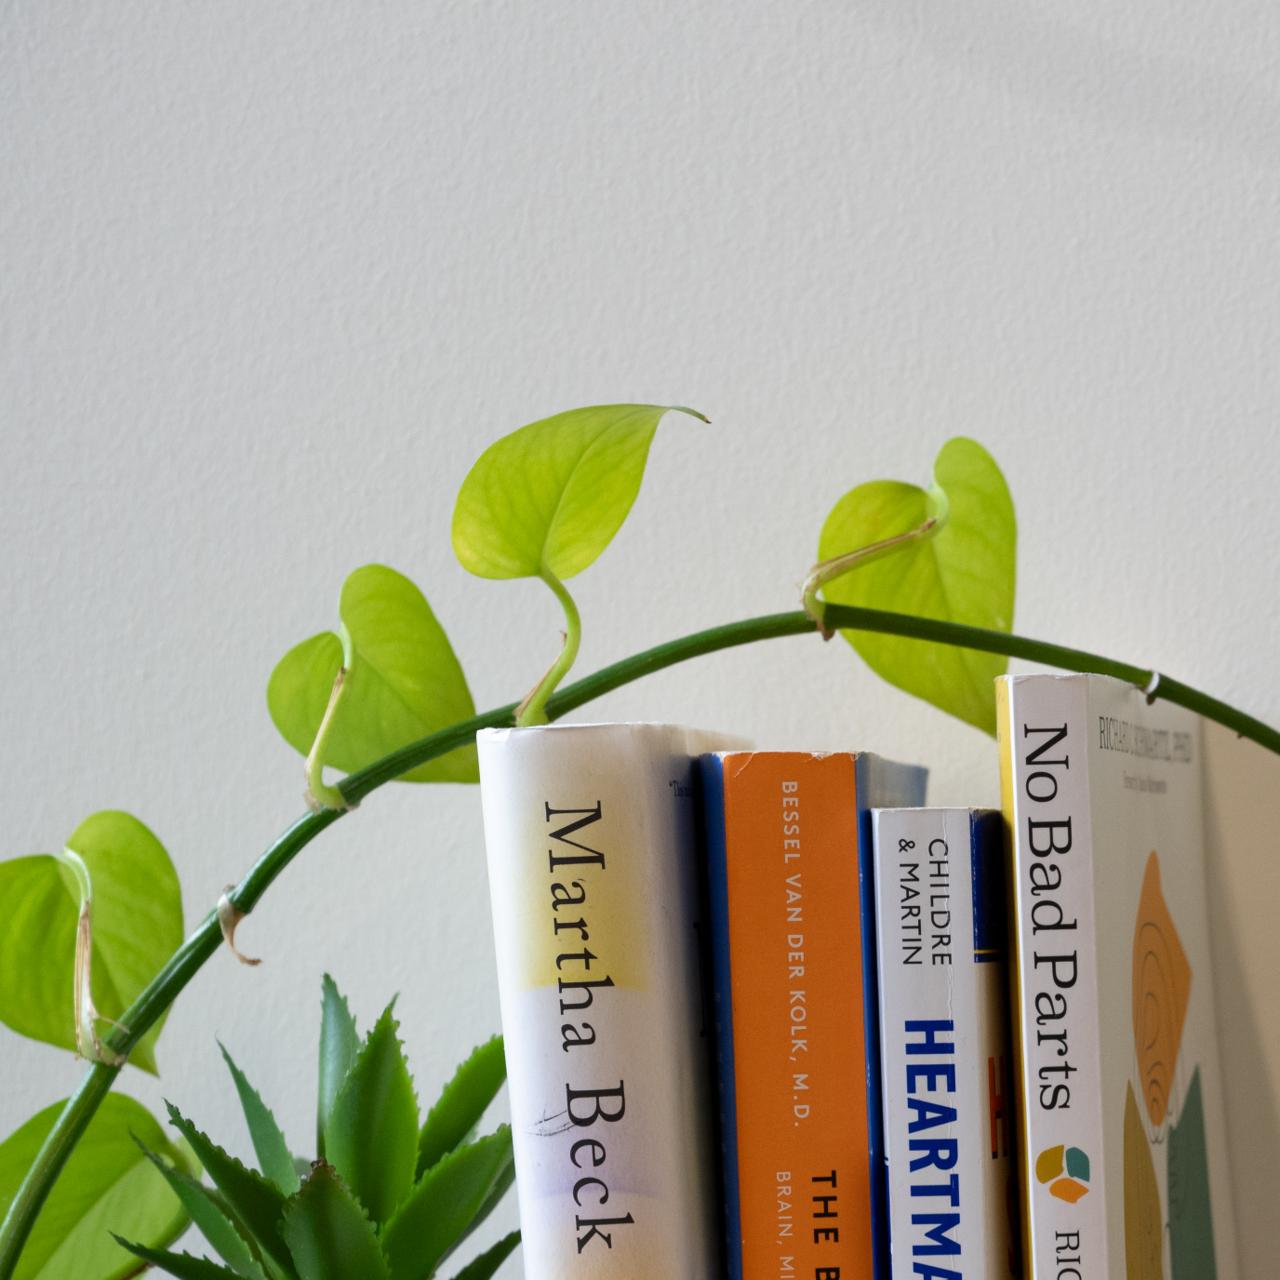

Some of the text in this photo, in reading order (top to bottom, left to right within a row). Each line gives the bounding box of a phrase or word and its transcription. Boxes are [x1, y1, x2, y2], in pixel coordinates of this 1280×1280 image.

[782, 781, 809, 1126] BESSEL VAN DER KOLK, M.D.
[898, 838, 922, 965] & MARTIN
[928, 838, 952, 966] CHILDRE
[1024, 723, 1078, 1110] No Bad Parts
[544, 800, 635, 1254] Martha Beck
[776, 1172, 793, 1245] BRAIN,
[812, 1170, 839, 1244] THE
